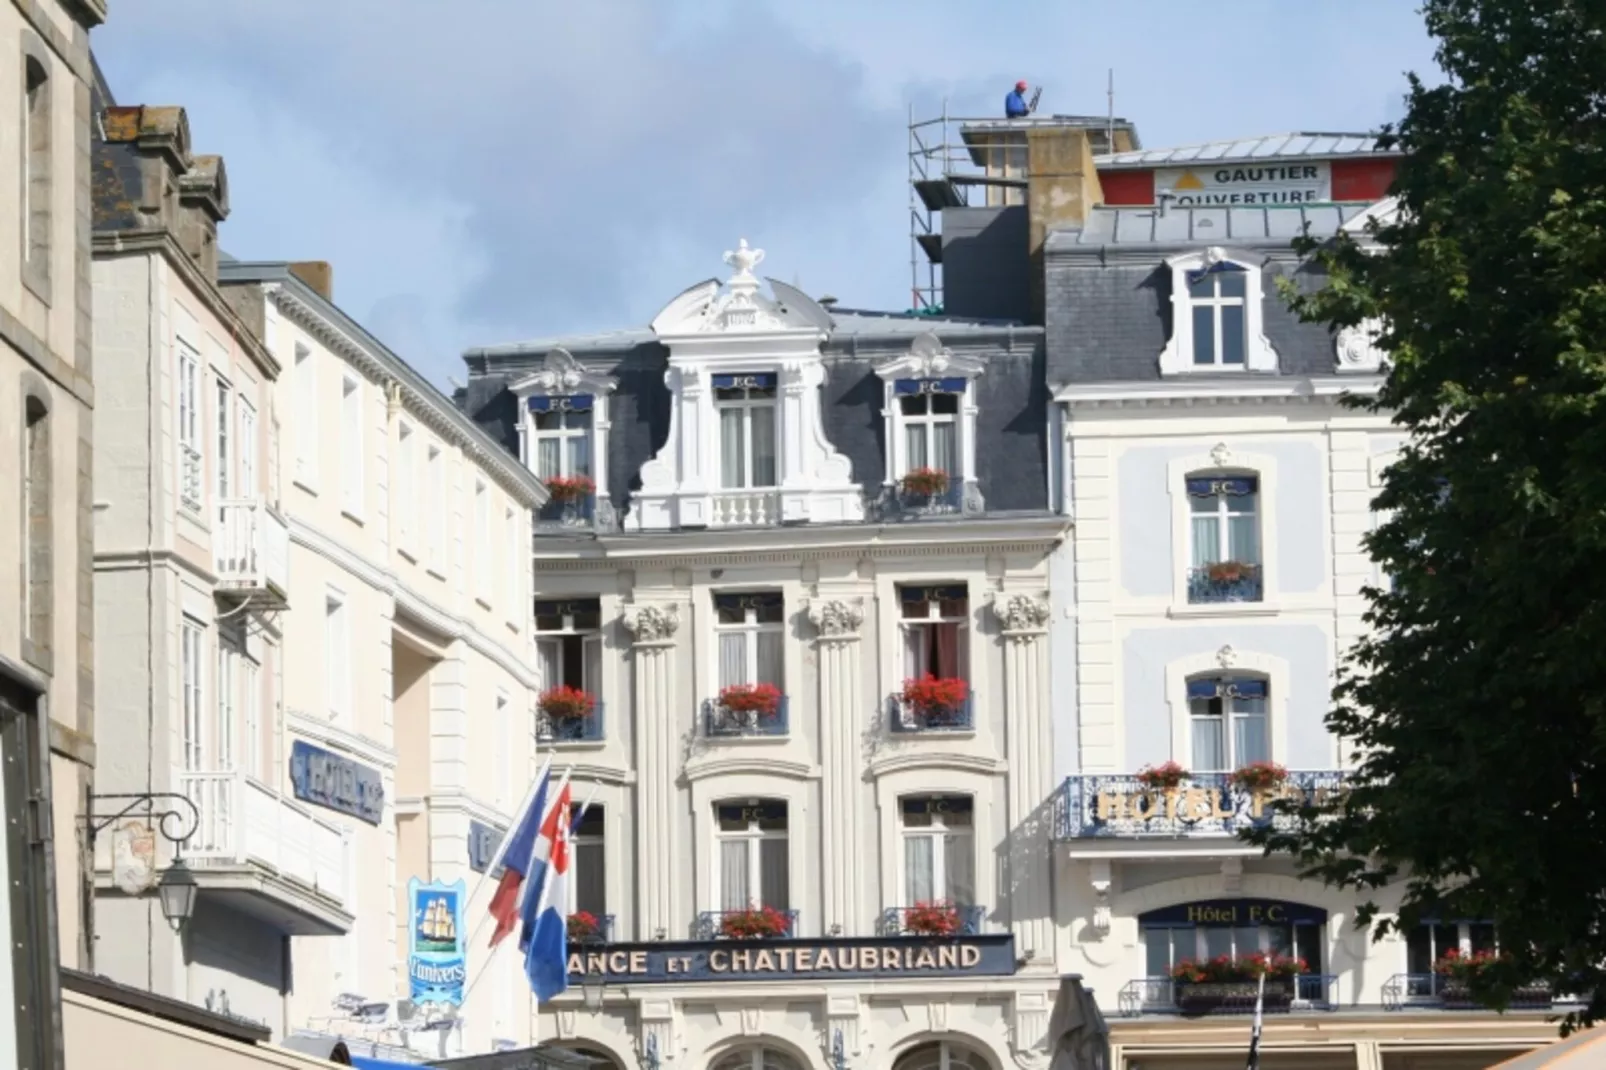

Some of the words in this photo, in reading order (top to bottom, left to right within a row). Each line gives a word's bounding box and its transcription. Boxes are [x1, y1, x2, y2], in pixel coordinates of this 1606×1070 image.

[1214, 166, 1318, 183] GAUTIER
[1166, 190, 1316, 205] OUVERTURE
[1187, 905, 1236, 922] Hôtel
[566, 950, 648, 975] ANCE
[667, 956, 692, 974] ET
[709, 944, 982, 973] CHATEAUBRIAND
